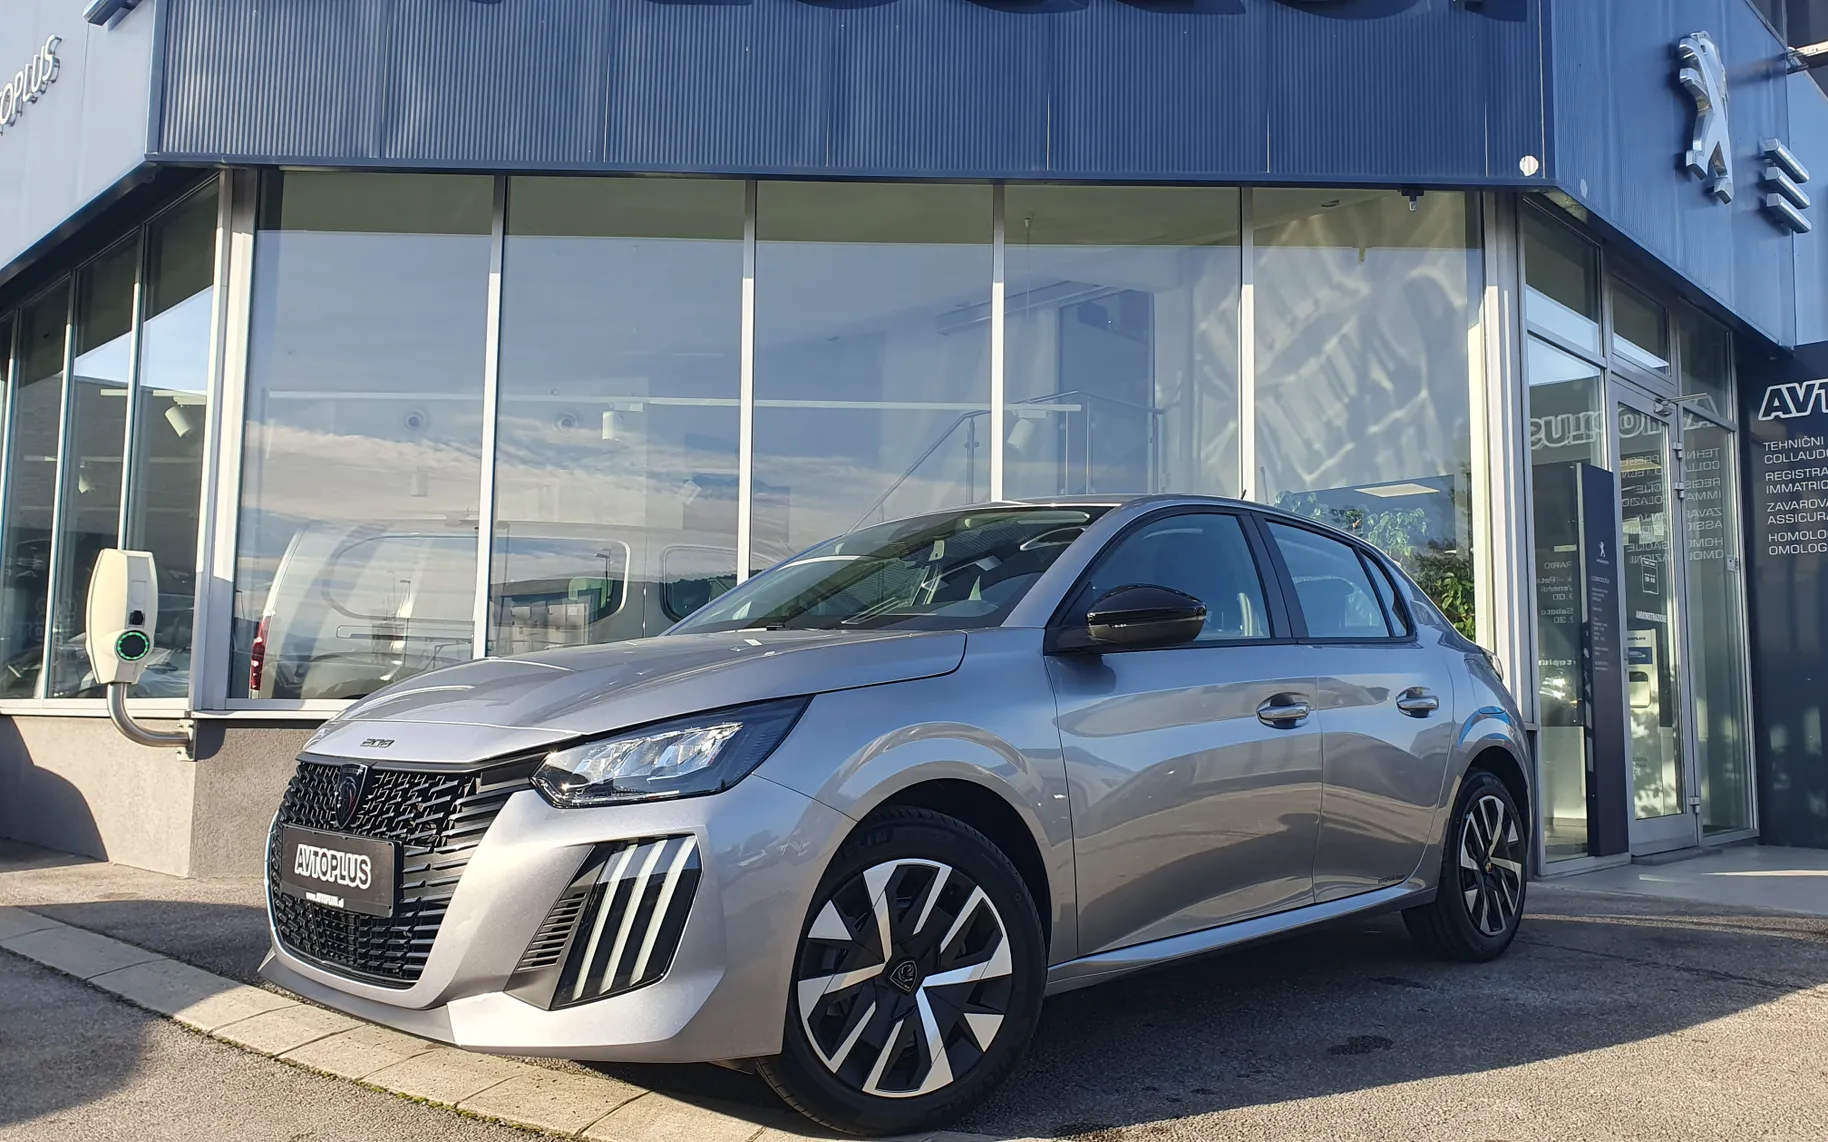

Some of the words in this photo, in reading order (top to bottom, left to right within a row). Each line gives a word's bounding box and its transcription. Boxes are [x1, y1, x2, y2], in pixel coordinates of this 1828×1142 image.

[0, 34, 60, 125] OPLUS
[1763, 435, 1824, 451] TEHNIČNI
[1764, 449, 1828, 464] COLLAUD
[1765, 467, 1828, 481] REGISTRA
[1767, 511, 1828, 524] ASSICUR
[1768, 529, 1828, 542] HOMOLO
[1768, 542, 1828, 555] OMOLOG
[360, 738, 395, 748] 208
[294, 843, 372, 890] AVTOPLUS
